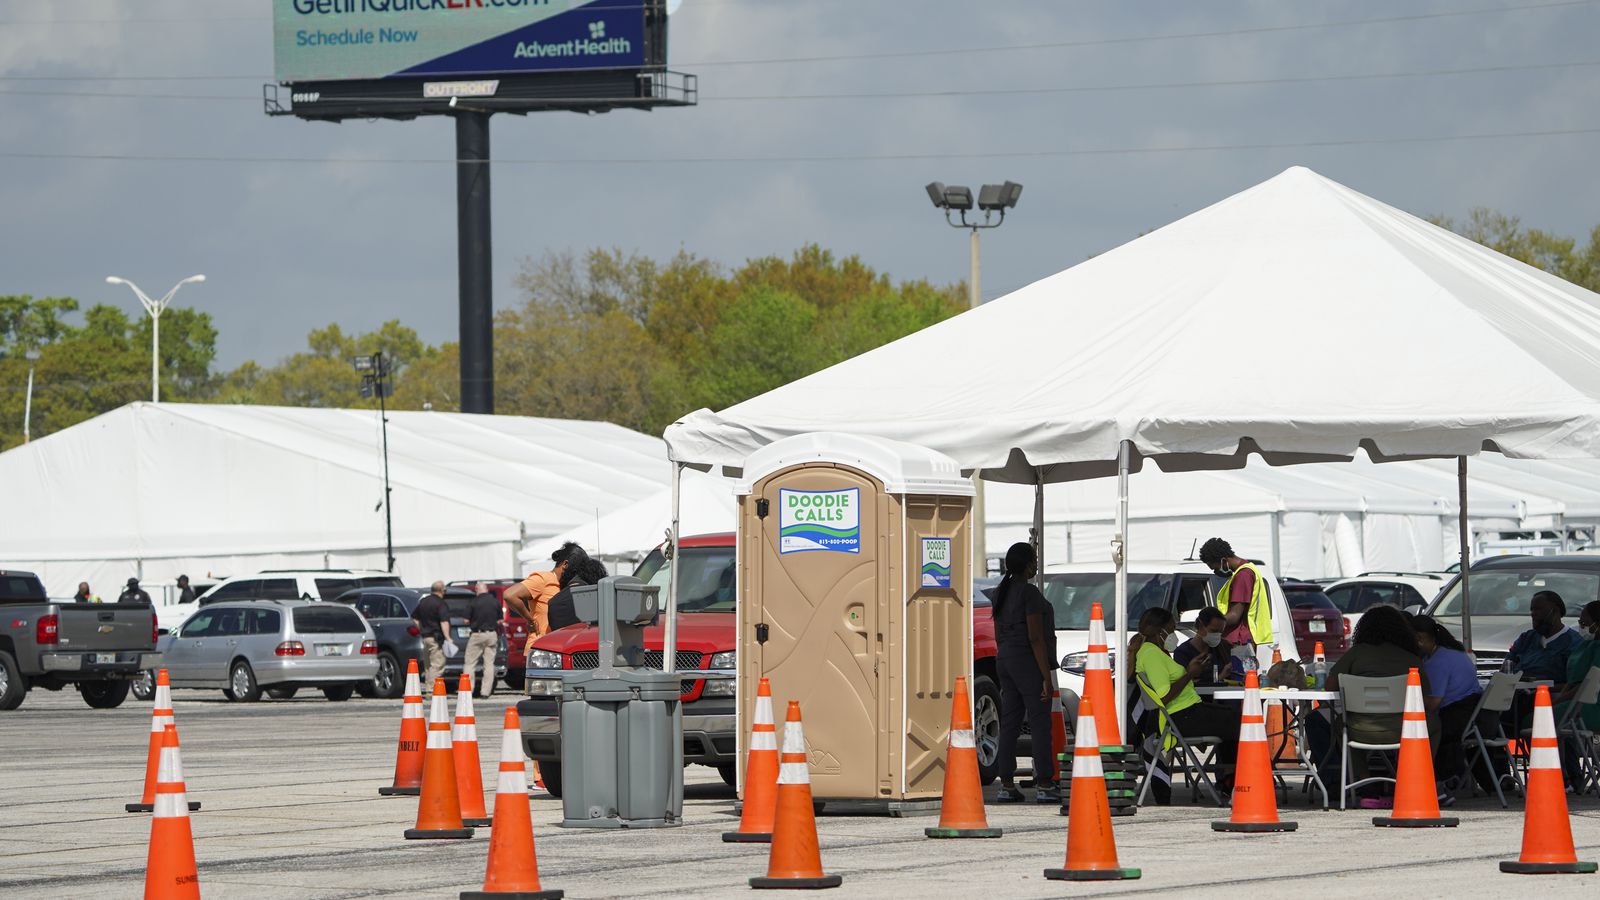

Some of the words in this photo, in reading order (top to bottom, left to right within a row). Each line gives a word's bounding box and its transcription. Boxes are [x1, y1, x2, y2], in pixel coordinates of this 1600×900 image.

[296, 29, 374, 47] Schedule
[379, 28, 418, 43] Now
[514, 38, 631, 58] AdventHealth
[426, 82, 496, 97] OUTFRONT
[788, 494, 849, 508] DOODIE
[794, 508, 843, 521] CALLS
[926, 540, 946, 550] DOODIE
[928, 550, 944, 560] CALLS
